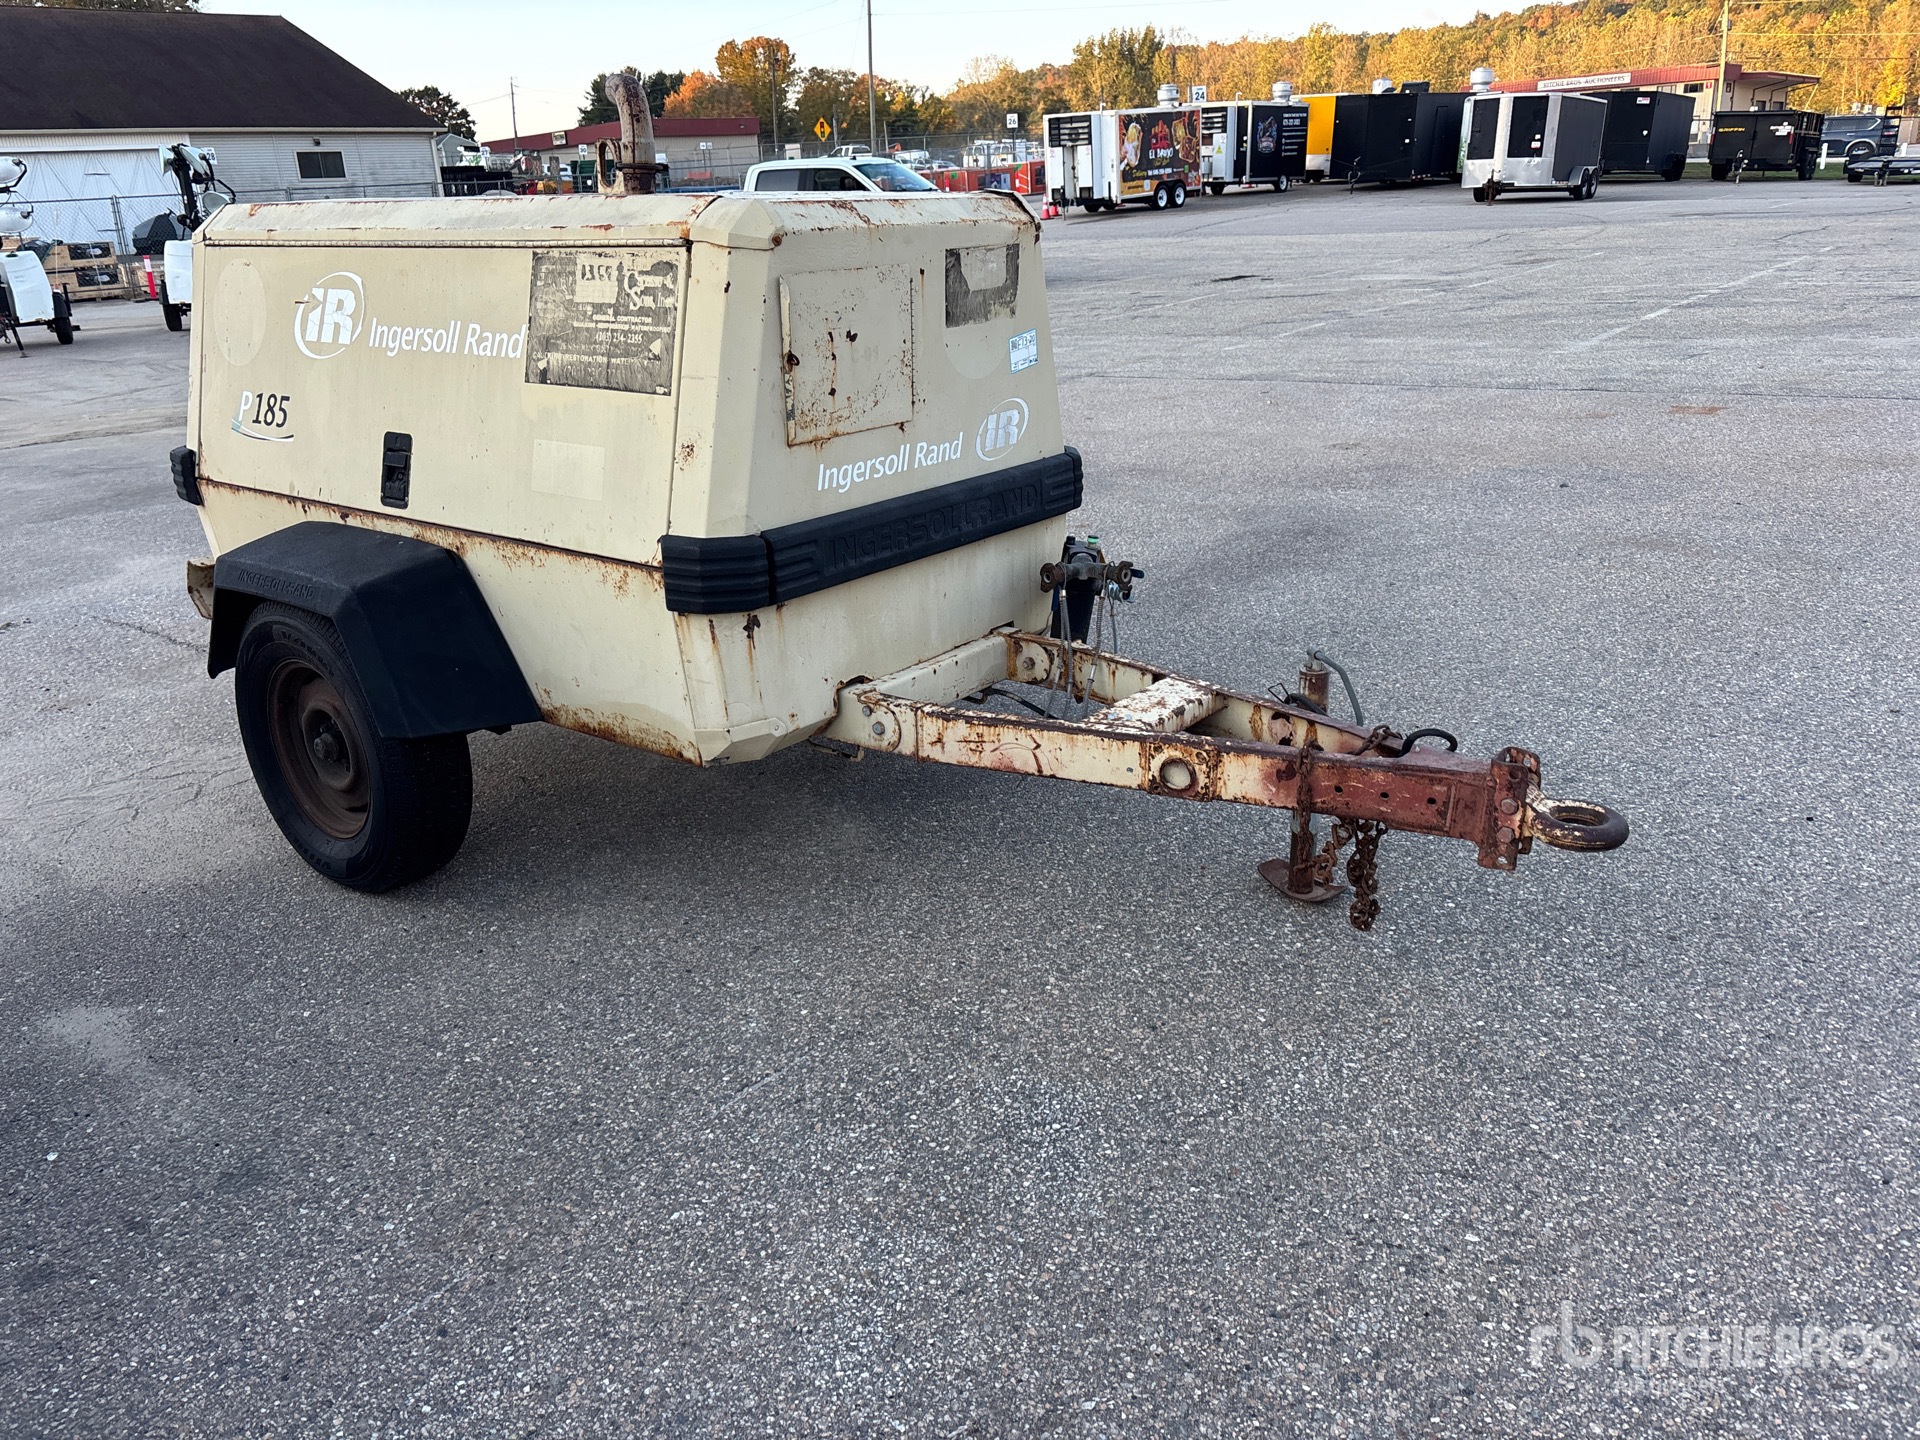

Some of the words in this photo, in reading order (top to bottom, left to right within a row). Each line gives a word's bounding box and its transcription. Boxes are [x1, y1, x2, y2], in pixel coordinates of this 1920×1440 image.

[1195, 91, 1205, 100] 24
[206, 152, 215, 160] 28
[616, 315, 652, 324] CONTRACTOR
[368, 316, 462, 357] Ingersoll
[463, 322, 529, 359] Rand
[816, 443, 911, 493] Ingersoll
[914, 431, 964, 469] Rand
